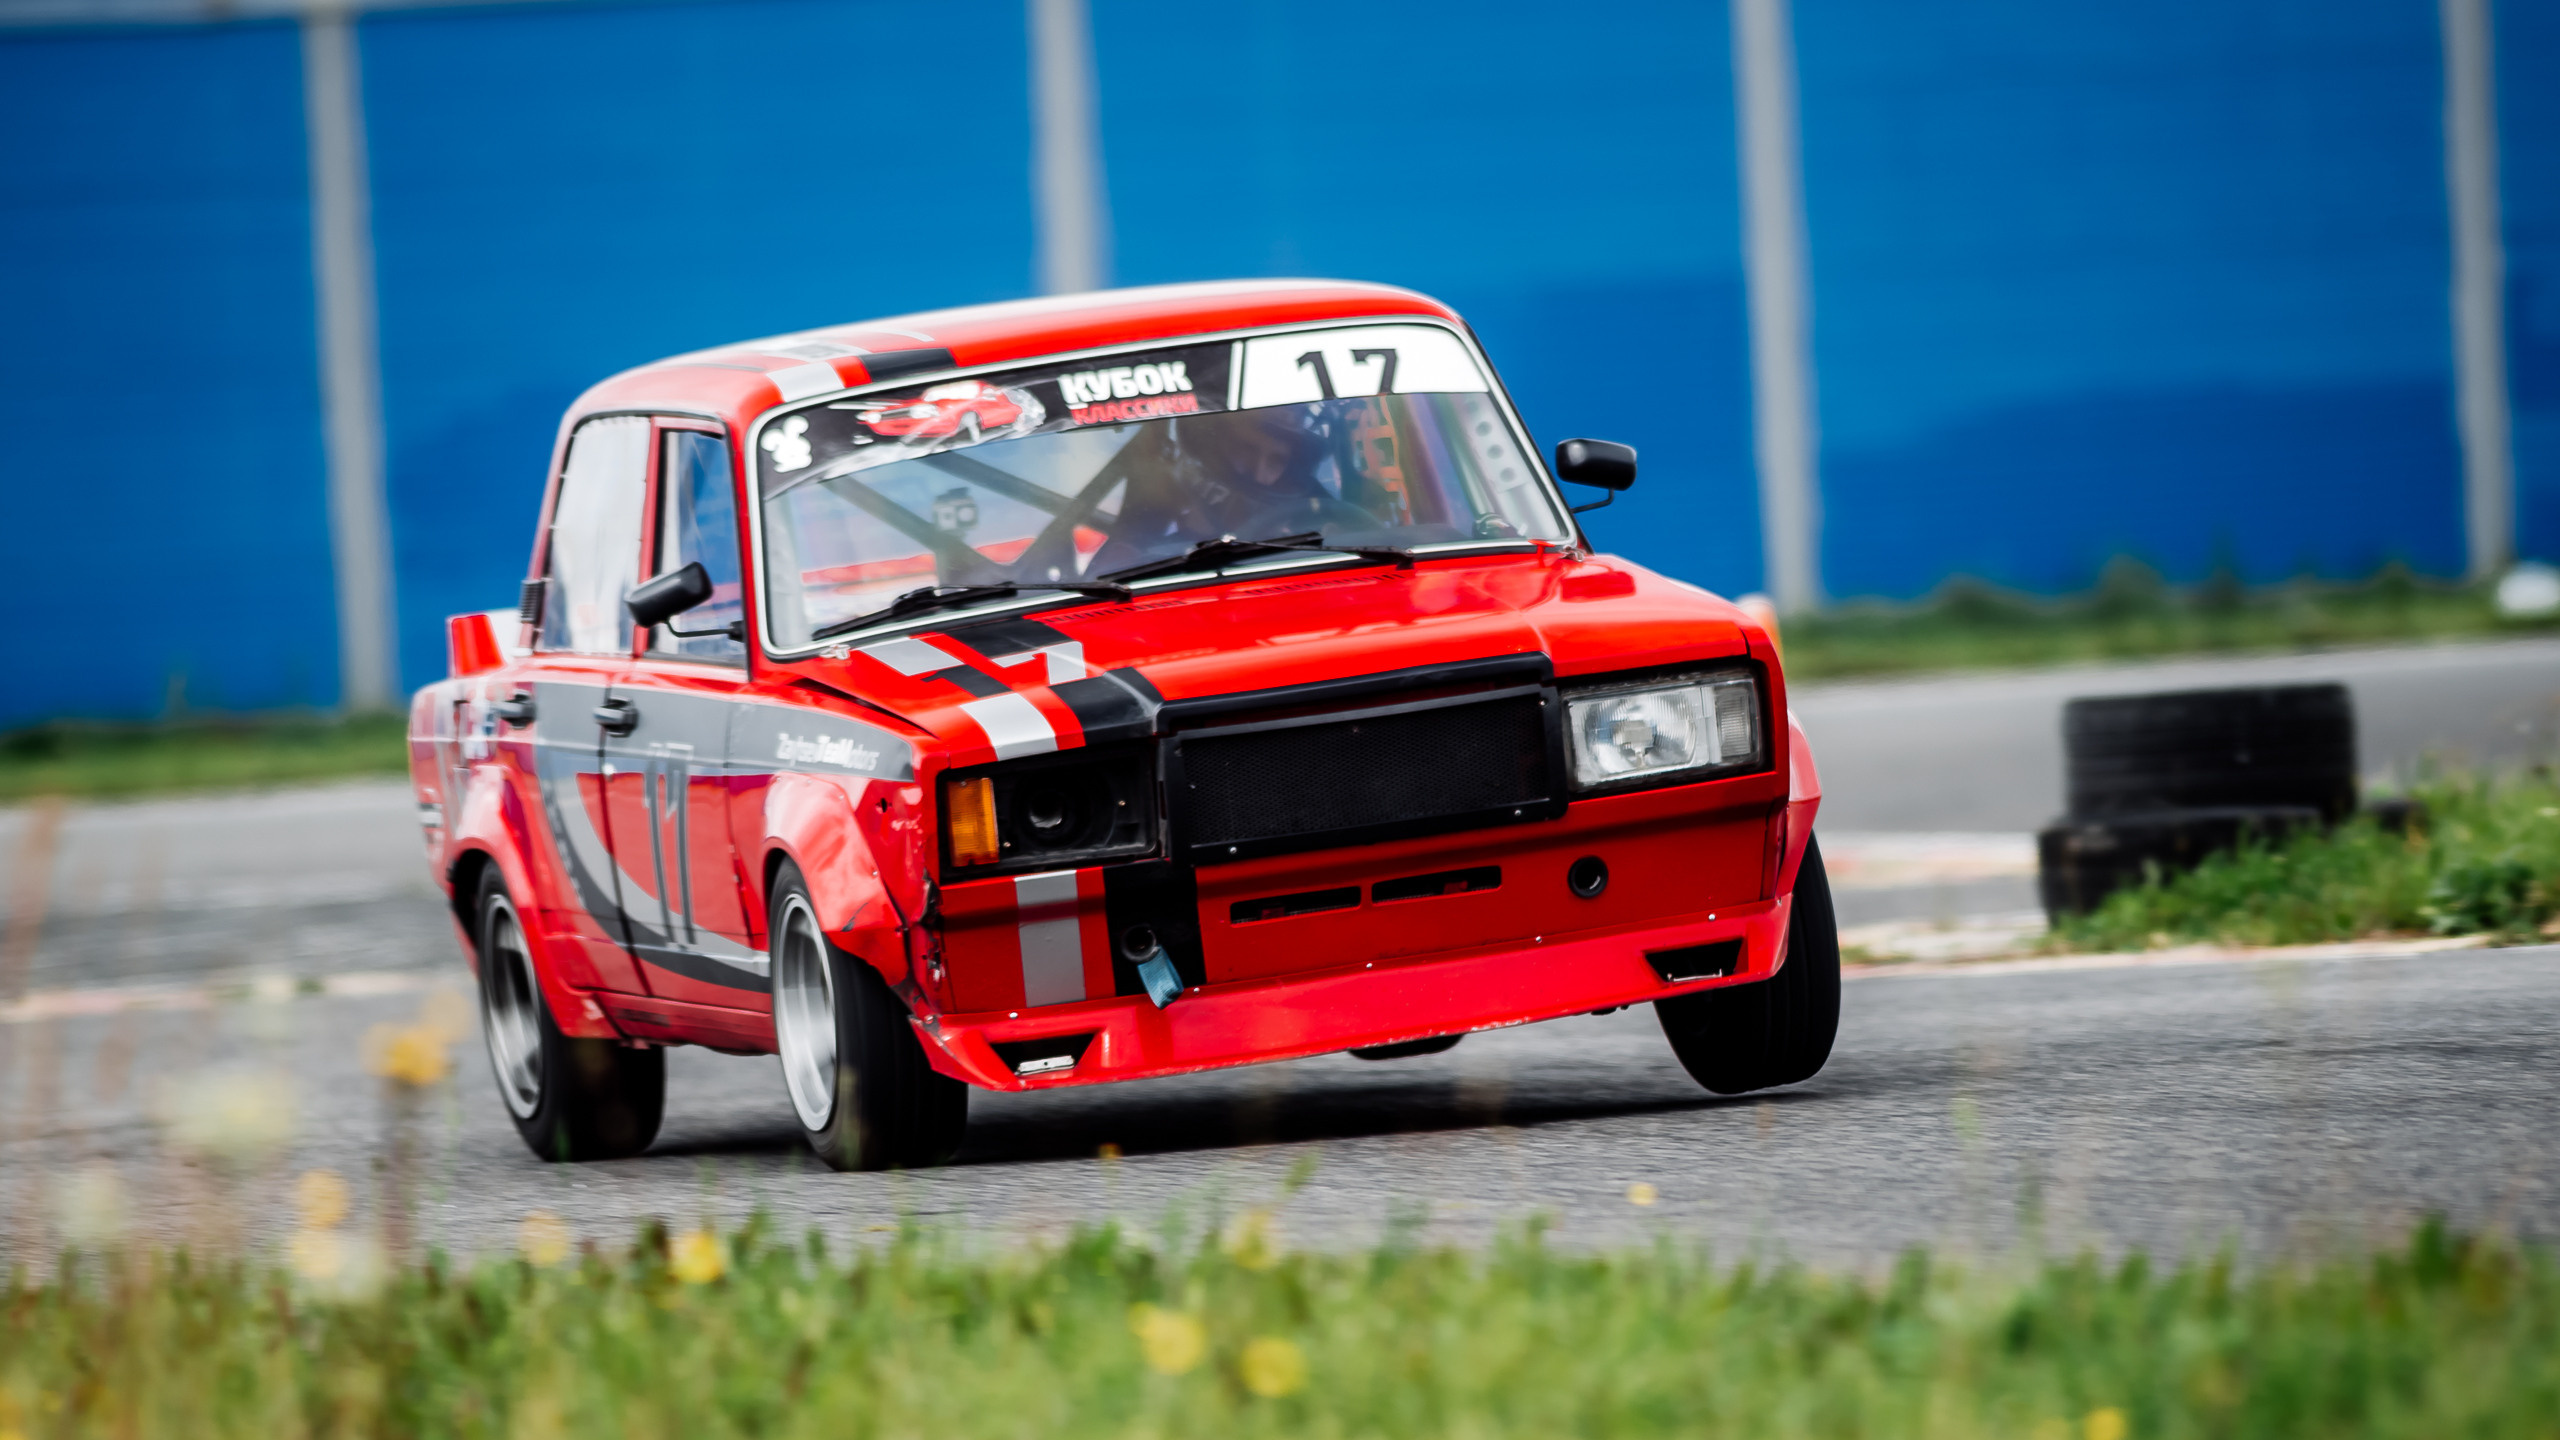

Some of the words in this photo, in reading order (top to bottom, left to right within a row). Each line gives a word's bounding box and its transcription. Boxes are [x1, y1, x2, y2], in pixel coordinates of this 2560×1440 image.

[1058, 361, 1193, 404] КУБОК
[1296, 349, 1398, 400] 17
[1068, 393, 1200, 426] КЛАССИКИ
